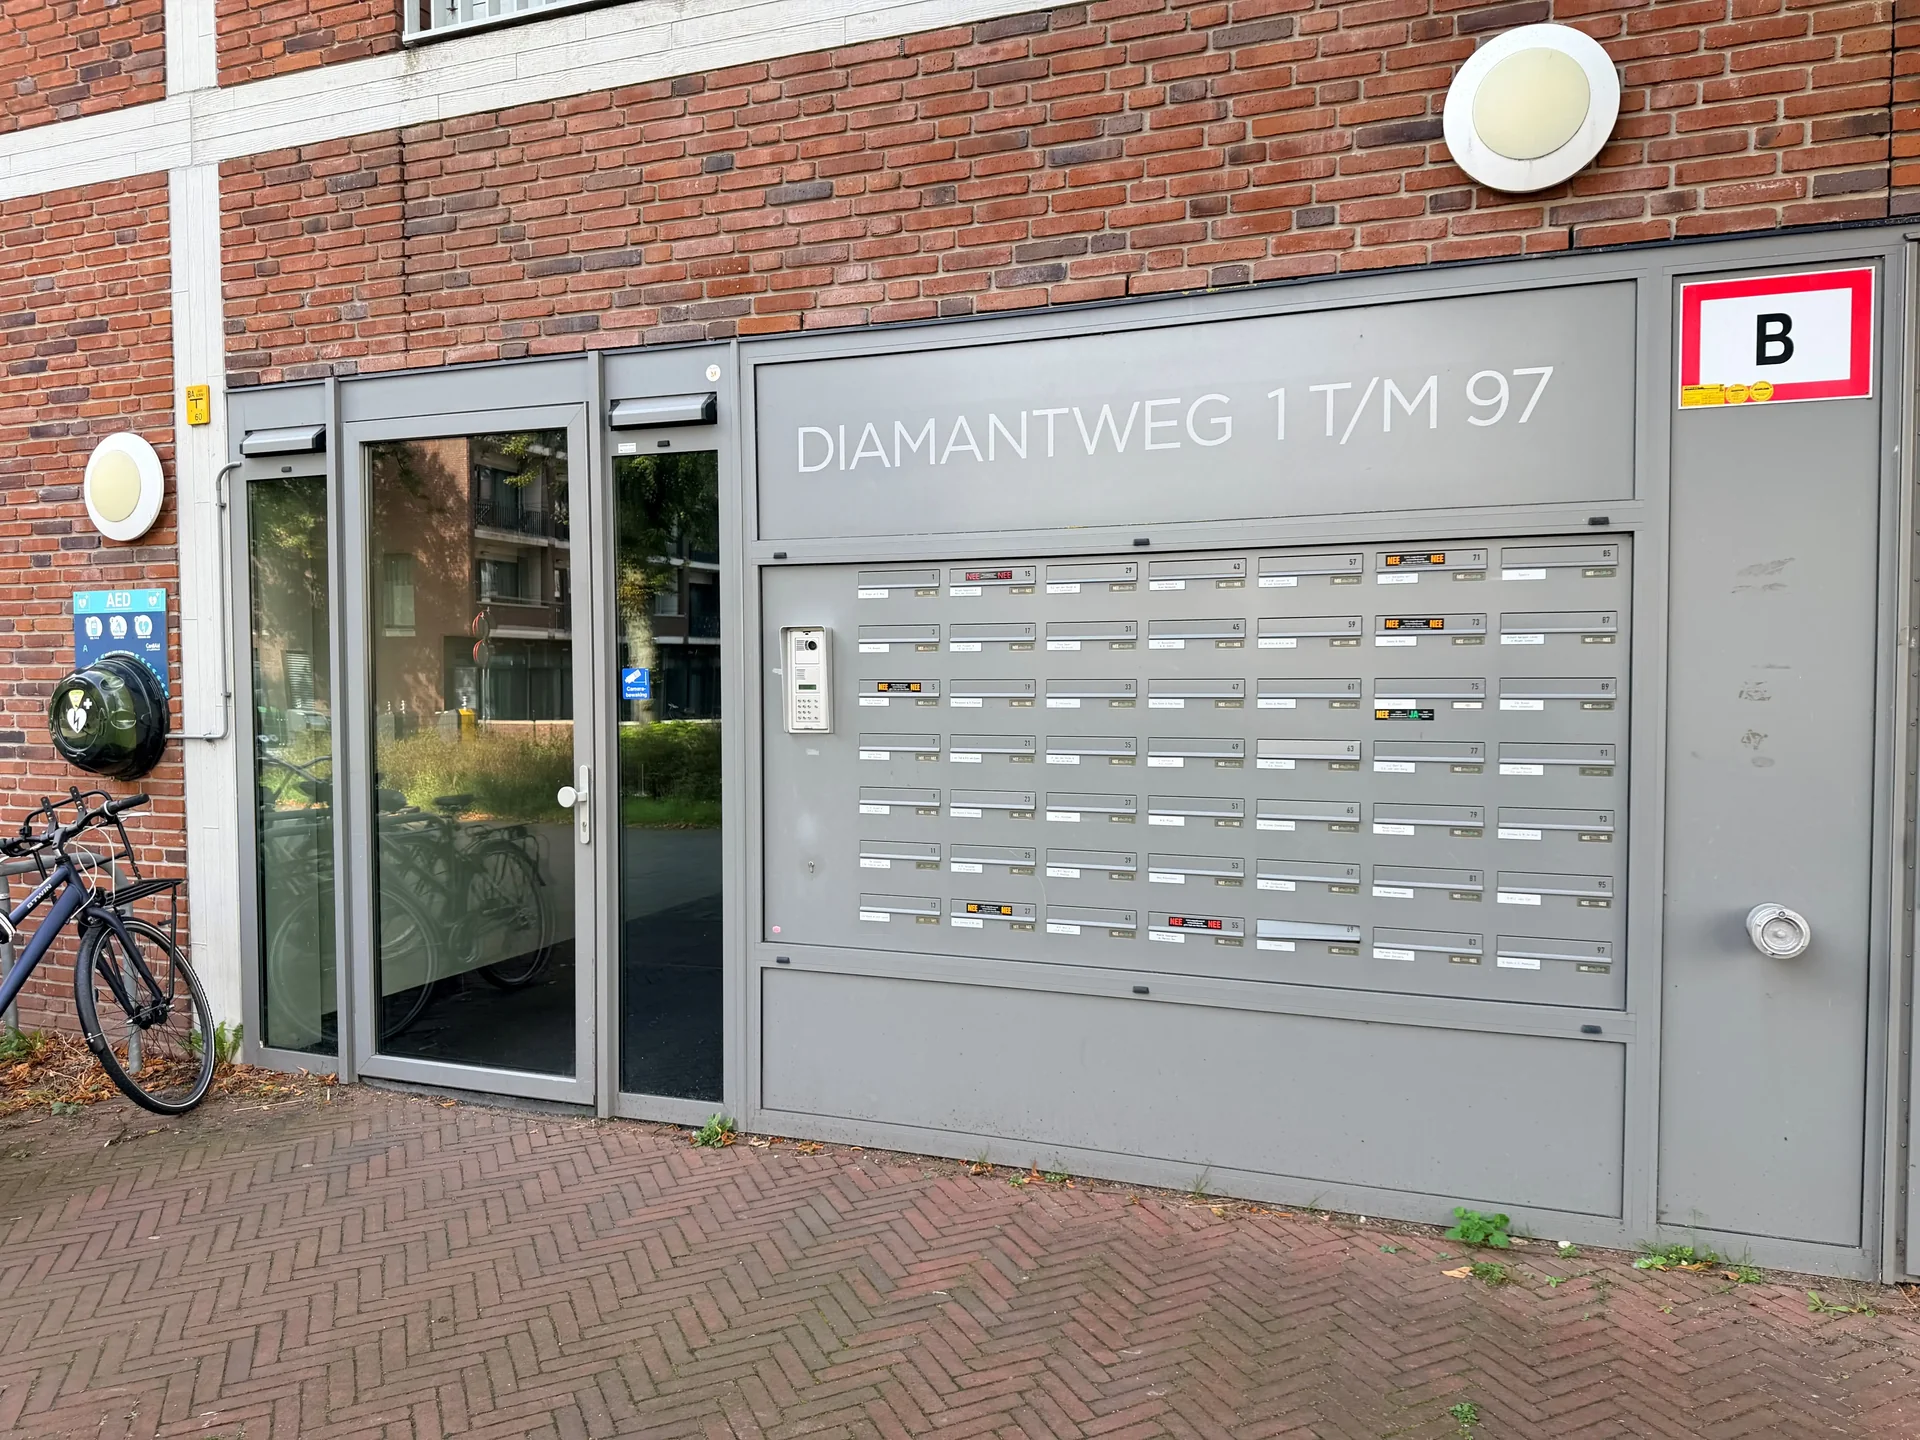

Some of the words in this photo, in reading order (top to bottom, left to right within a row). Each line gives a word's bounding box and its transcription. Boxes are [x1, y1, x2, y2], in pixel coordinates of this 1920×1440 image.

[1756, 312, 1795, 366] B
[797, 392, 1233, 475] DIAMANTWEG
[1267, 389, 1286, 441] 1
[1309, 375, 1440, 446] T/M
[1465, 366, 1555, 427] 97
[106, 592, 131, 608] AED
